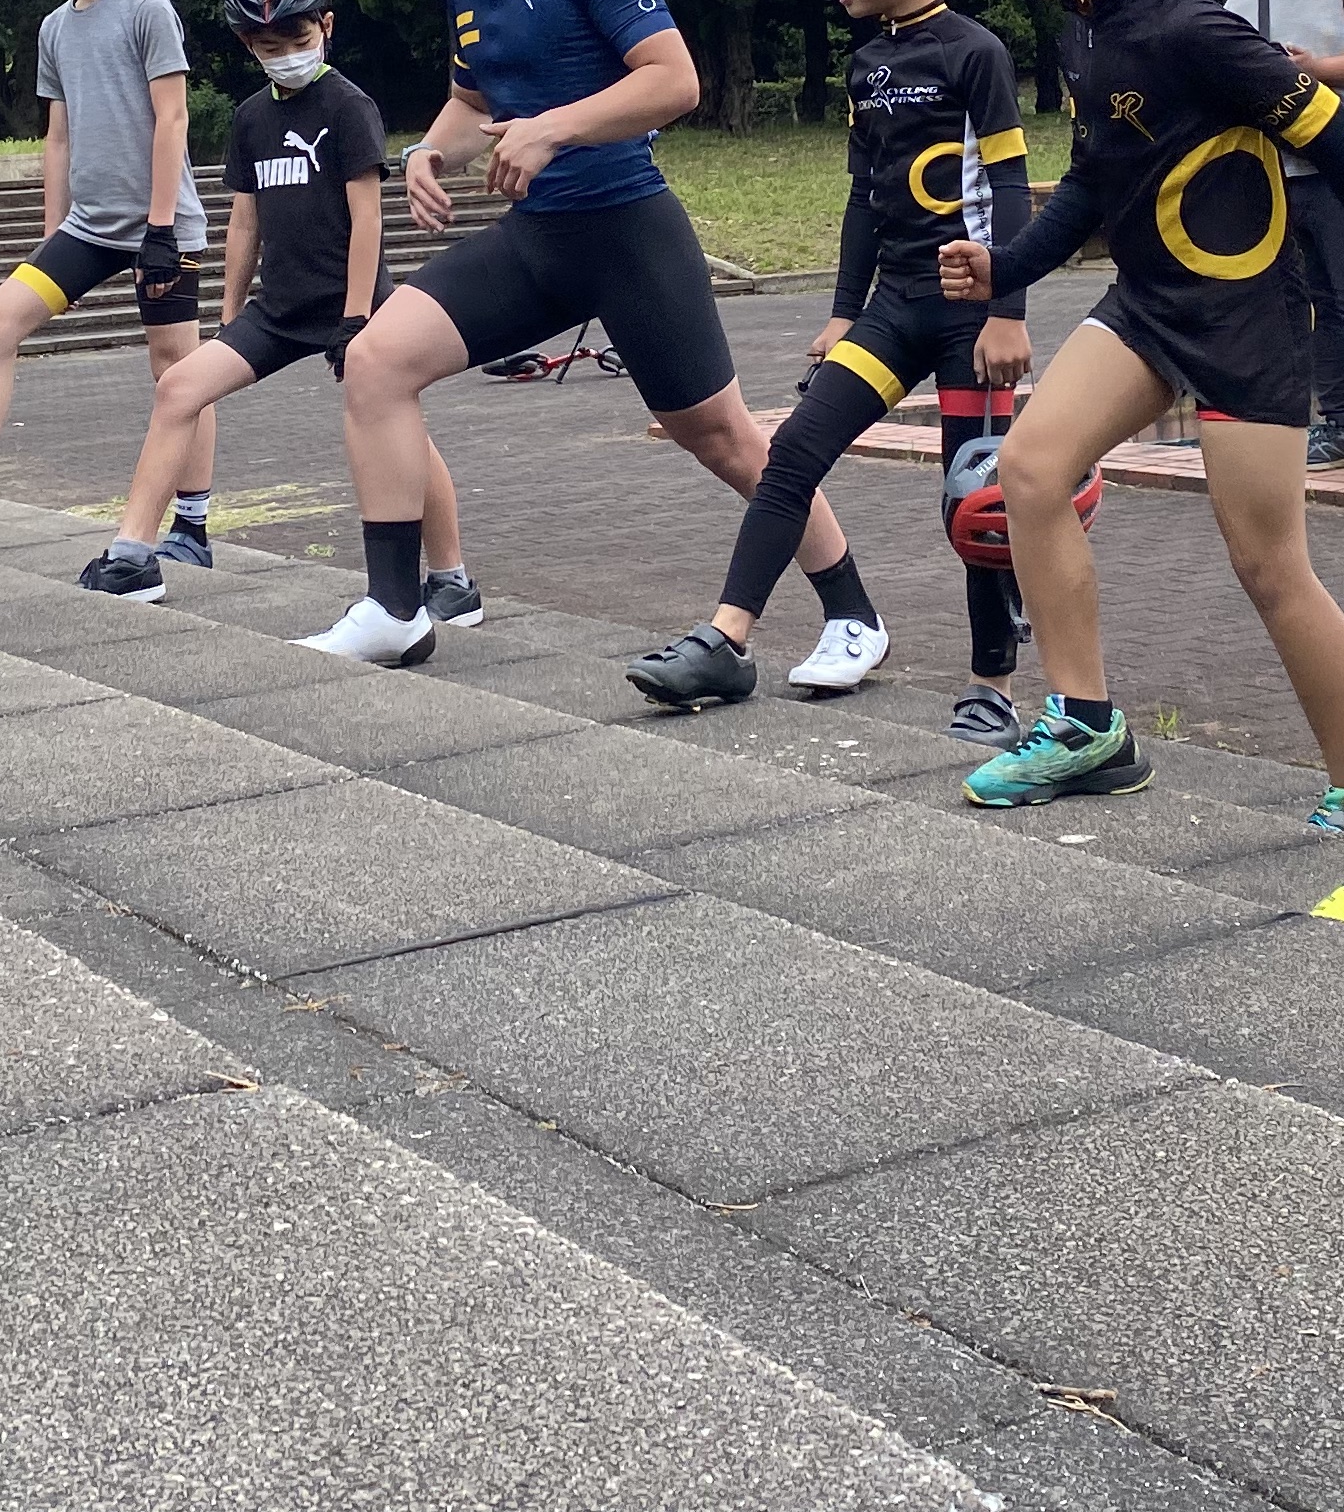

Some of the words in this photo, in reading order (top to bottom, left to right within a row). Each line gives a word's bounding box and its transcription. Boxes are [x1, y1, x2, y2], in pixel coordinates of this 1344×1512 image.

[886, 86, 938, 95] CYCLING
[890, 94, 945, 104] FITNESS
[1265, 73, 1311, 125] OKINO
[254, 156, 309, 190] PUMA
[976, 456, 998, 476] MITH
